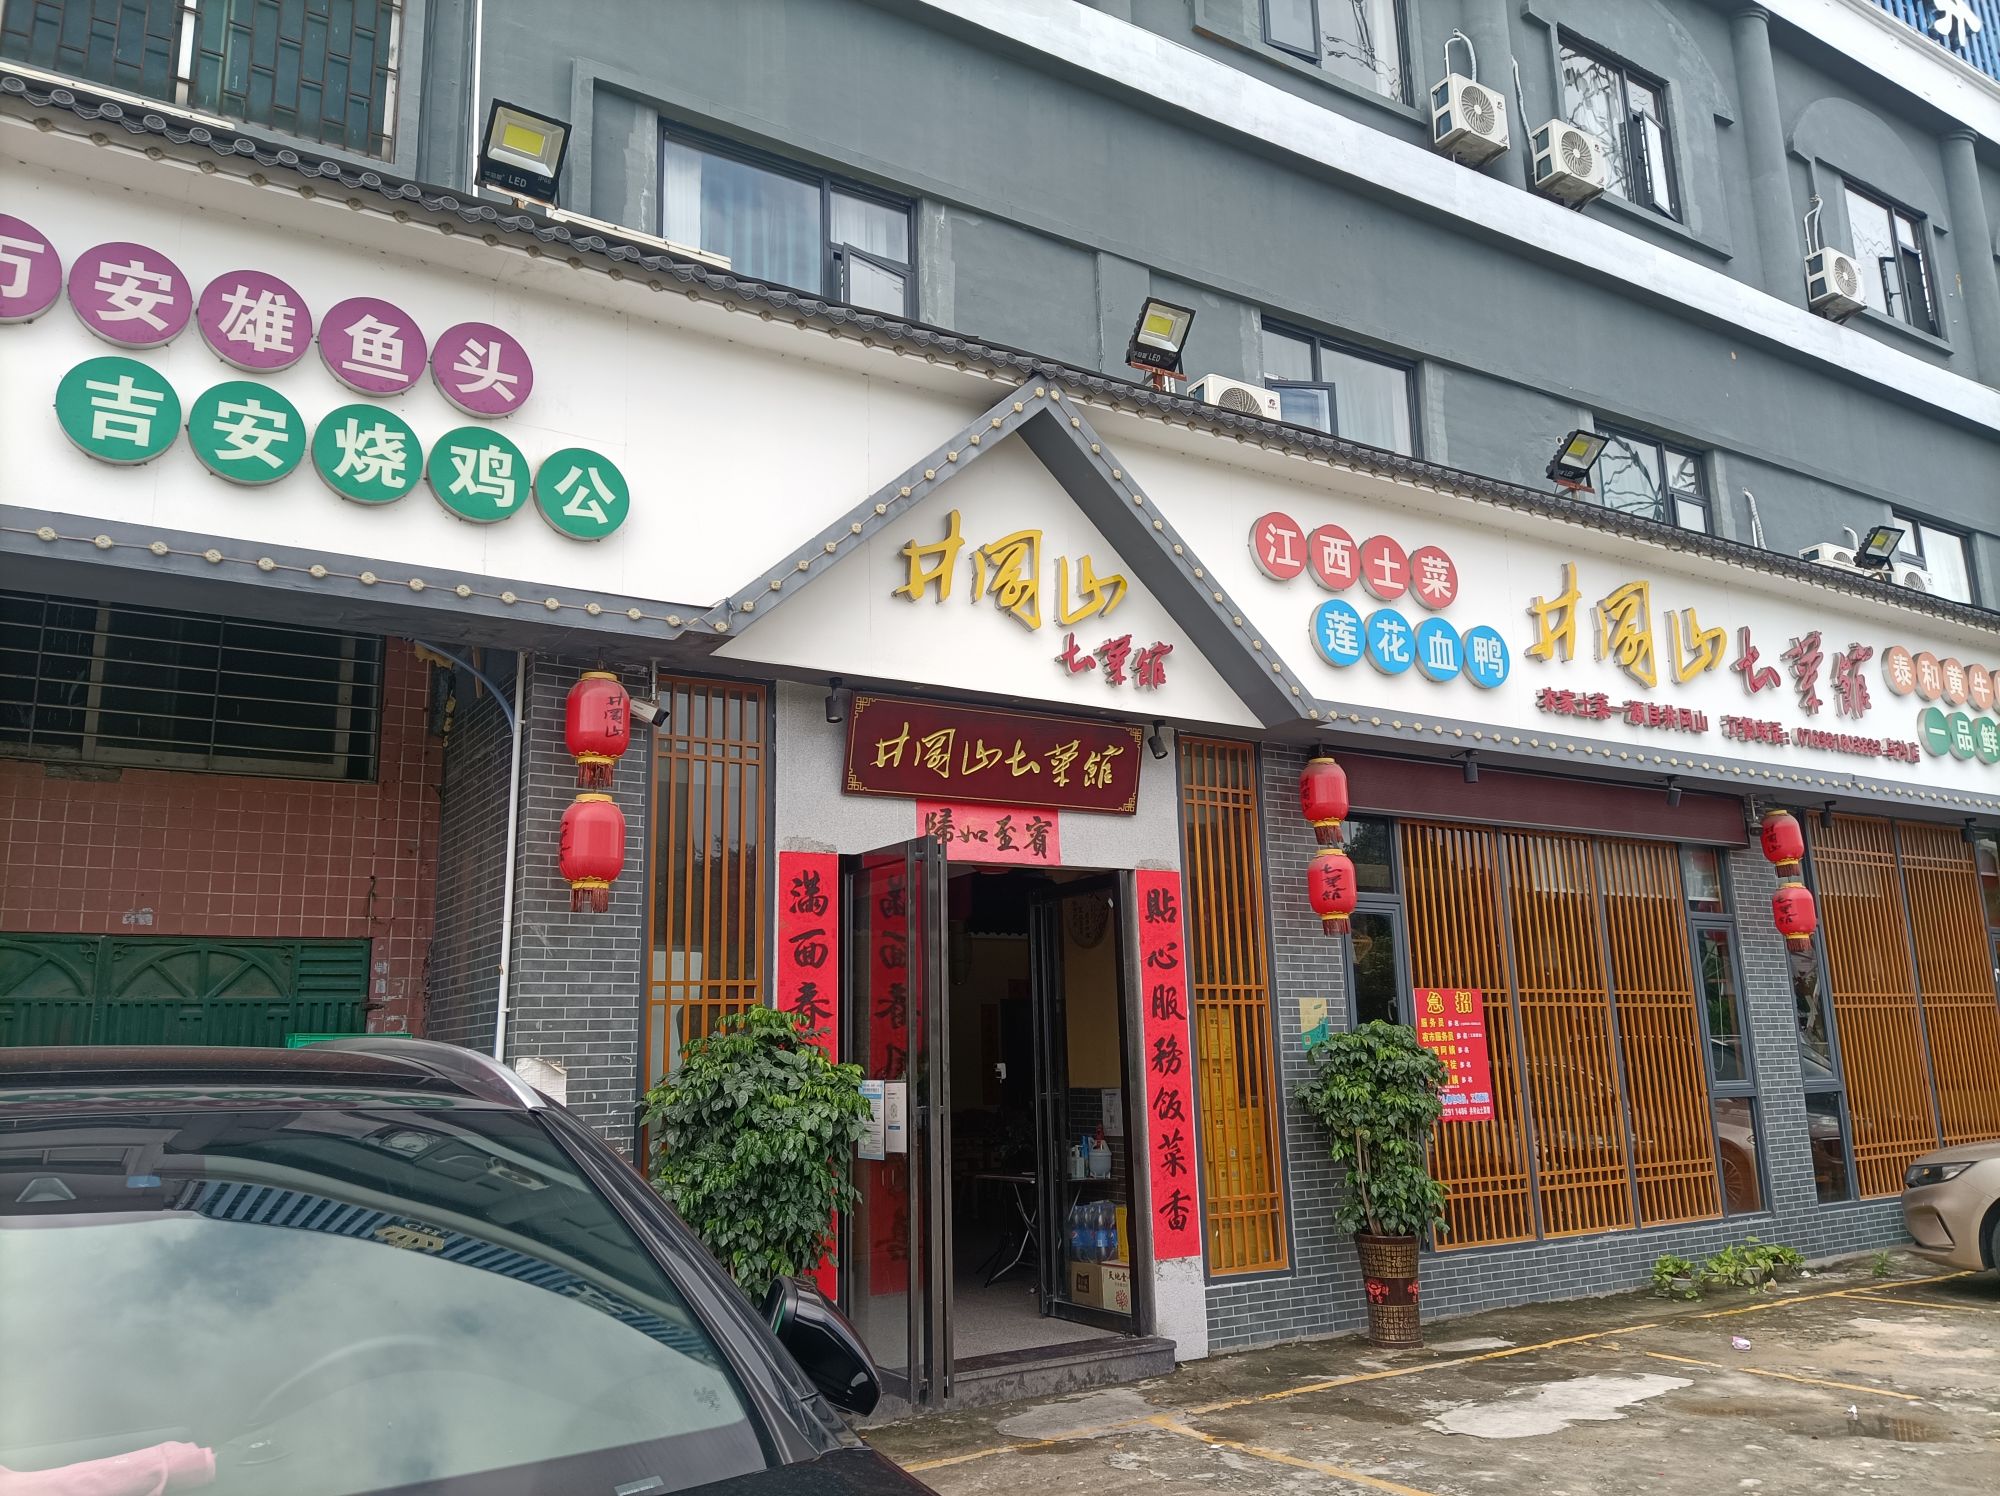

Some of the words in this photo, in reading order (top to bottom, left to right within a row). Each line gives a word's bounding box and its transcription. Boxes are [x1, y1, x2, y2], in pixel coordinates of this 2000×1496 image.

[508, 174, 527, 188] LED
[1148, 351, 1161, 363] LED
[85, 375, 616, 525] 吉安烧鸡公
[1264, 522, 1453, 599] 江西土菜
[1325, 610, 1504, 679] 莲花血鸭
[1892, 653, 2000, 703] 泰和黄牛
[1929, 719, 2000, 757] 一品鲜
[1426, 991, 1473, 1014] 急招
[1420, 1017, 1445, 1028] 服务员
